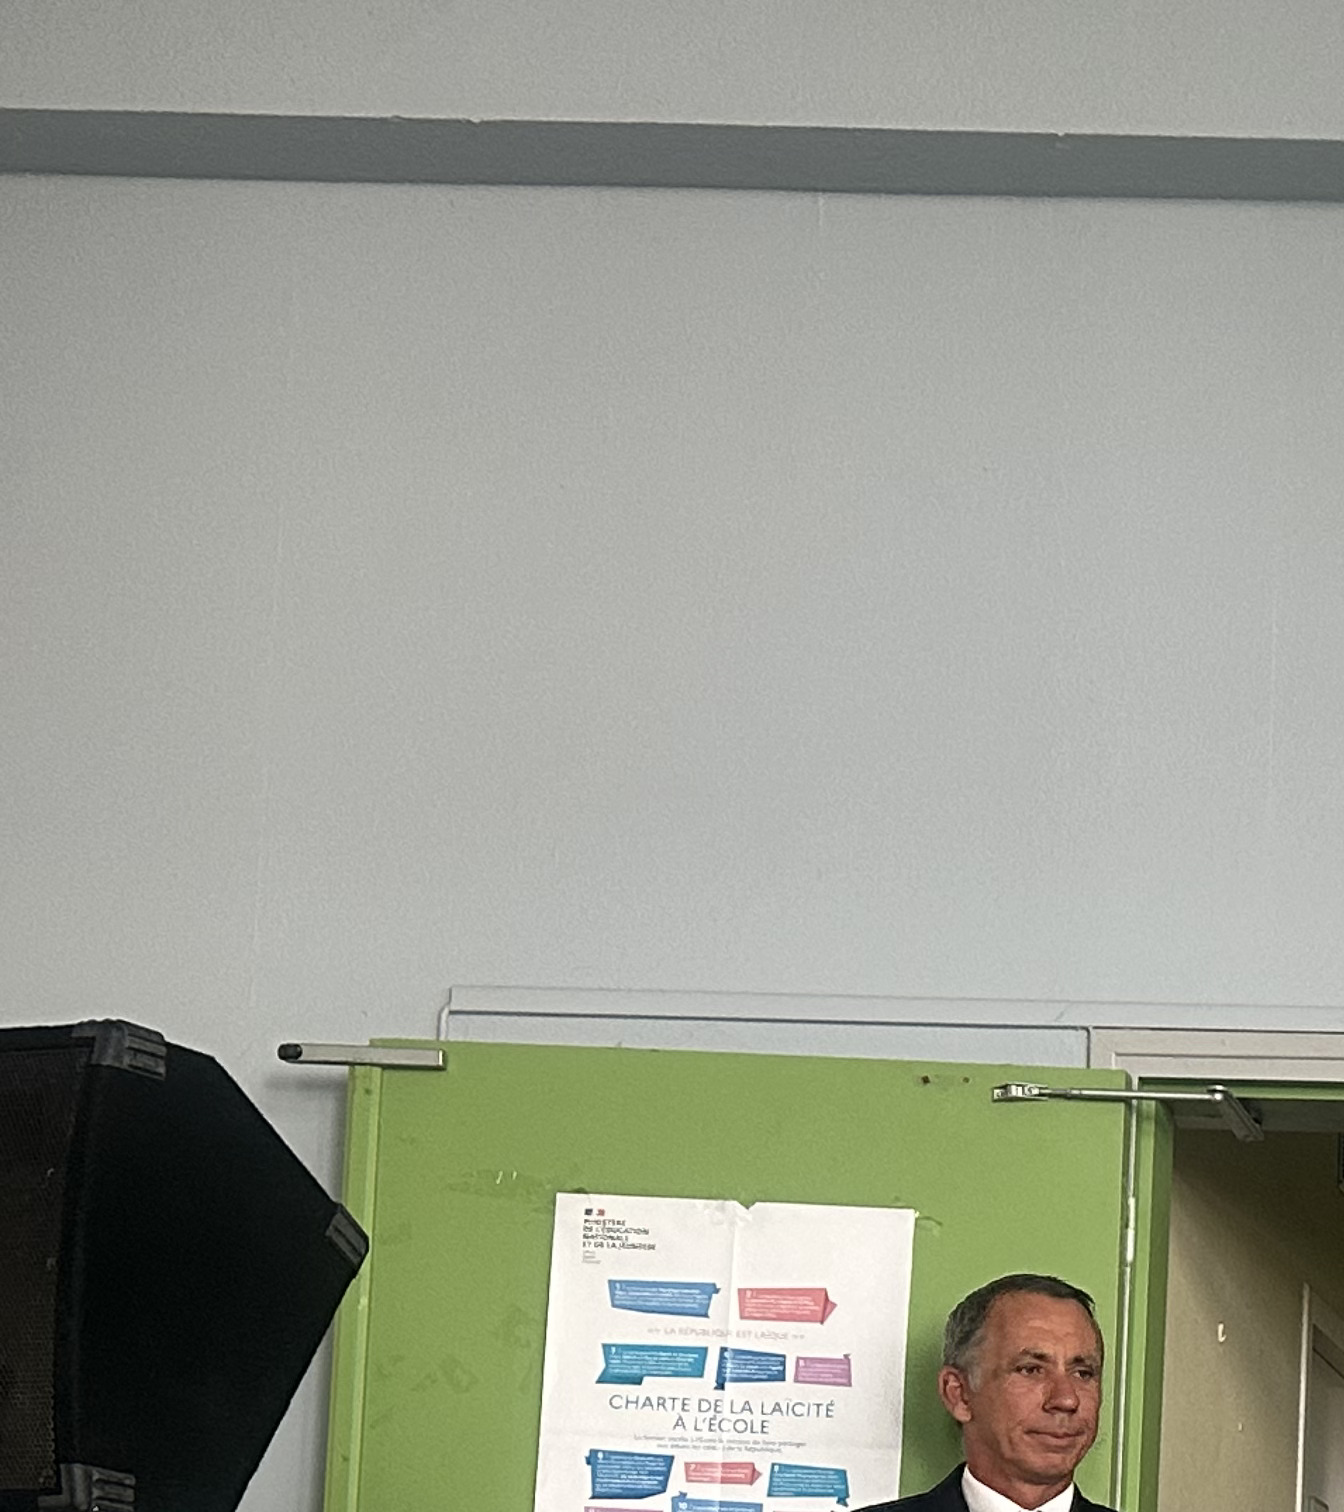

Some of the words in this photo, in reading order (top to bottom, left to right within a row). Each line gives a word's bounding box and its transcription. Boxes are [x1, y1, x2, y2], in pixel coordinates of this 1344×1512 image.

[608, 1394, 691, 1413] CHARTE
[697, 1398, 724, 1414] DE
[730, 1400, 754, 1416] LA
[760, 1398, 836, 1419] LAÏCITÉ
[672, 1412, 687, 1431] À
[693, 1414, 770, 1435] L'ÉCOLE
